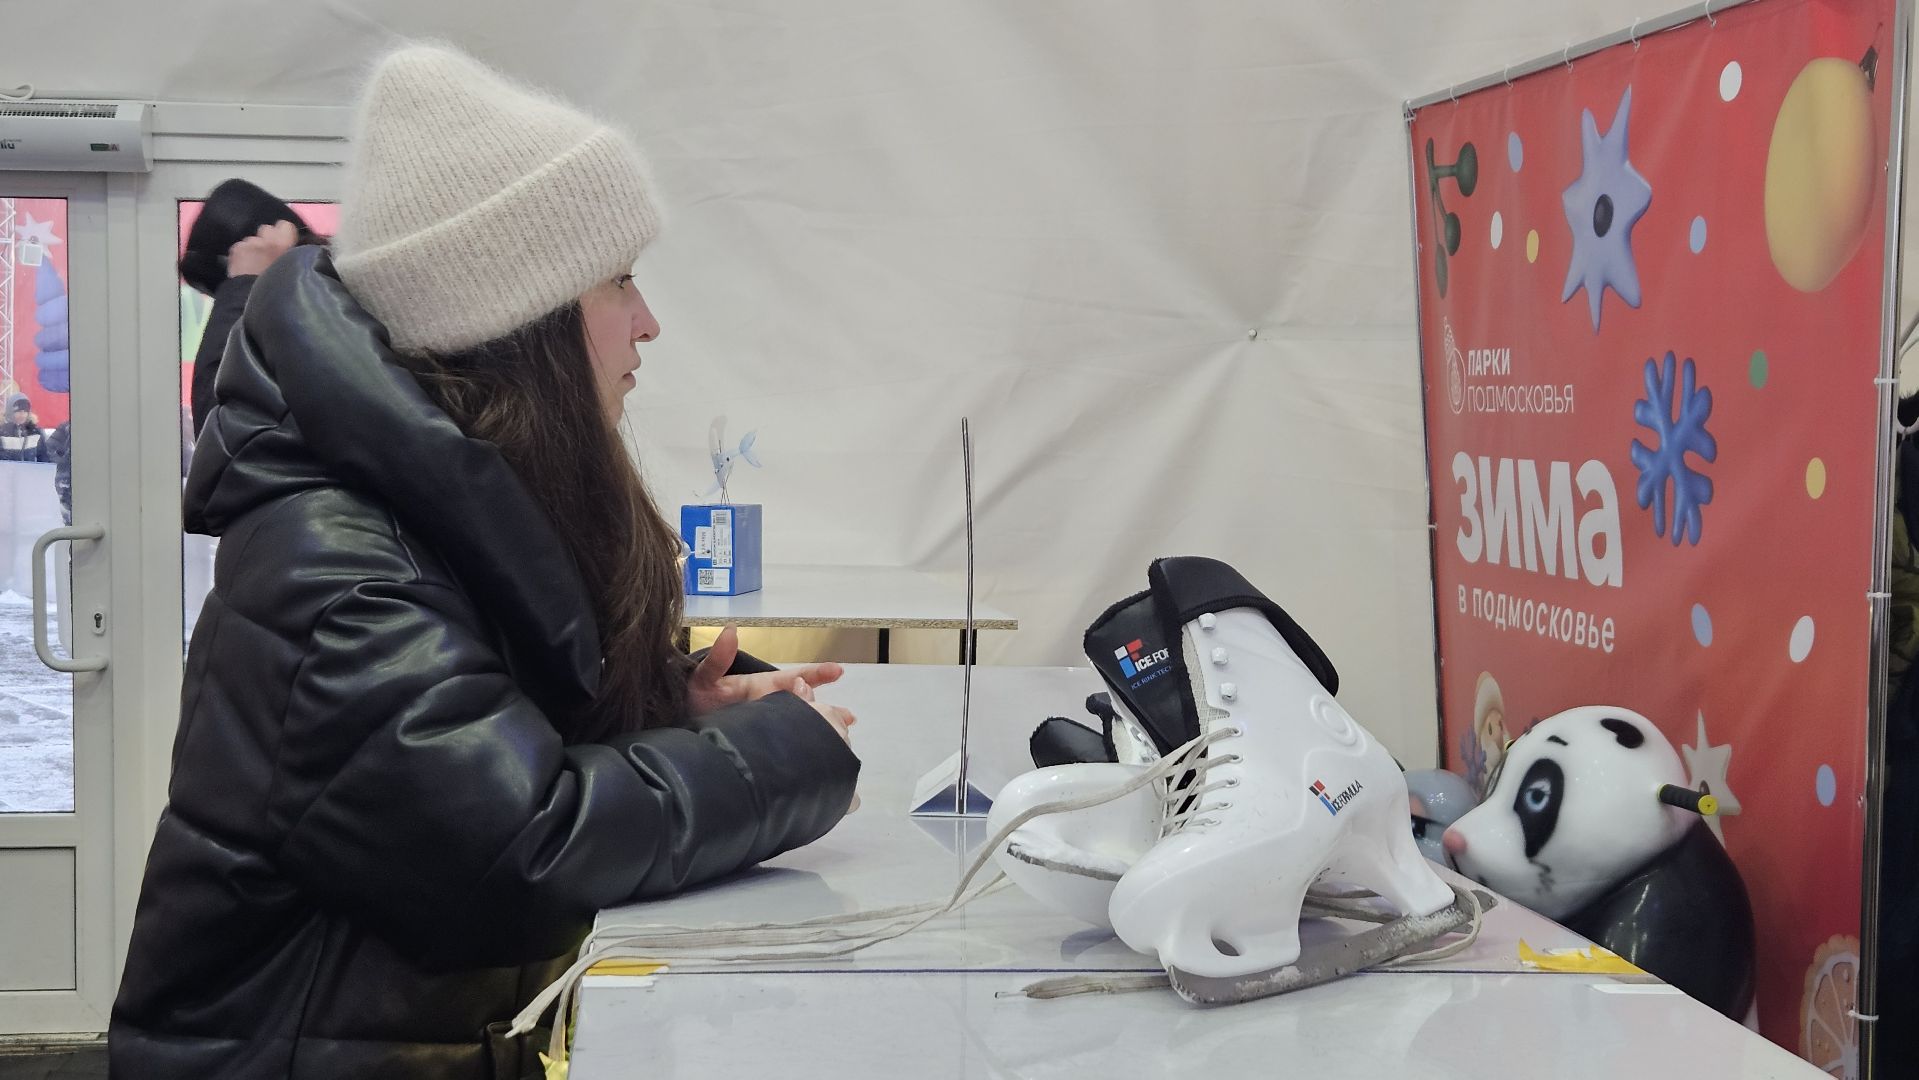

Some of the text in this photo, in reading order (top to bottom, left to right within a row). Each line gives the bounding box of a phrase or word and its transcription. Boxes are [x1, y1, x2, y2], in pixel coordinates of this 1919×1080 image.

[1468, 348, 1511, 376] ПАРКИ
[1467, 384, 1574, 414] ПОДМОСКОВЬЯ
[1135, 655, 1154, 672] ICE
